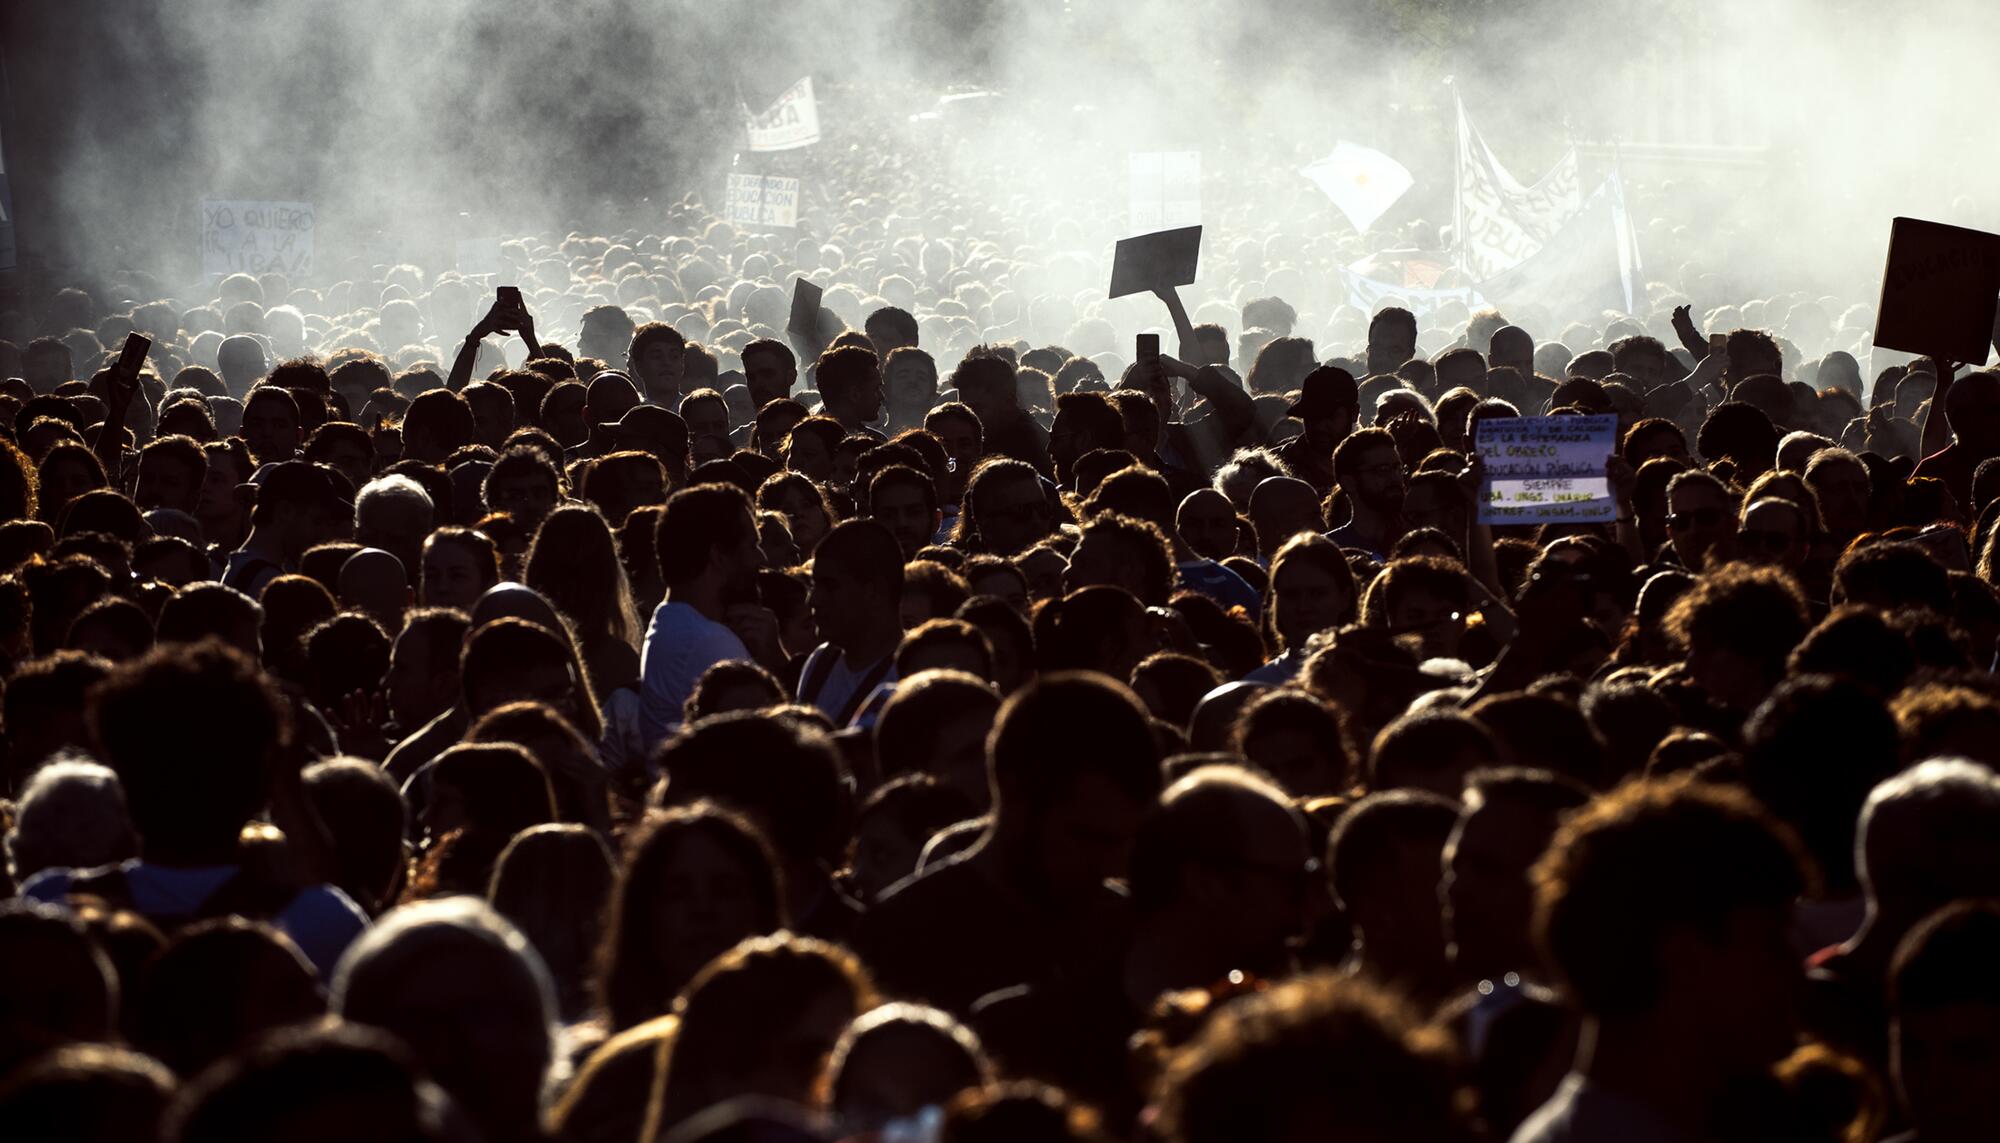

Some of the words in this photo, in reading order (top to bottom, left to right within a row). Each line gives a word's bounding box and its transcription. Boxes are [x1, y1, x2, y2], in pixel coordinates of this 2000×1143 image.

[205, 206, 235, 229] YO
[244, 207, 314, 232] QUIERO
[242, 231, 258, 251] A
[273, 233, 296, 253] LA
[1479, 434, 1494, 443] ES
[1501, 434, 1514, 443] LA
[1521, 433, 1591, 442] ESPERANZA
[1478, 446, 1501, 457] DEL
[1523, 479, 1572, 491] SIEMPRE
